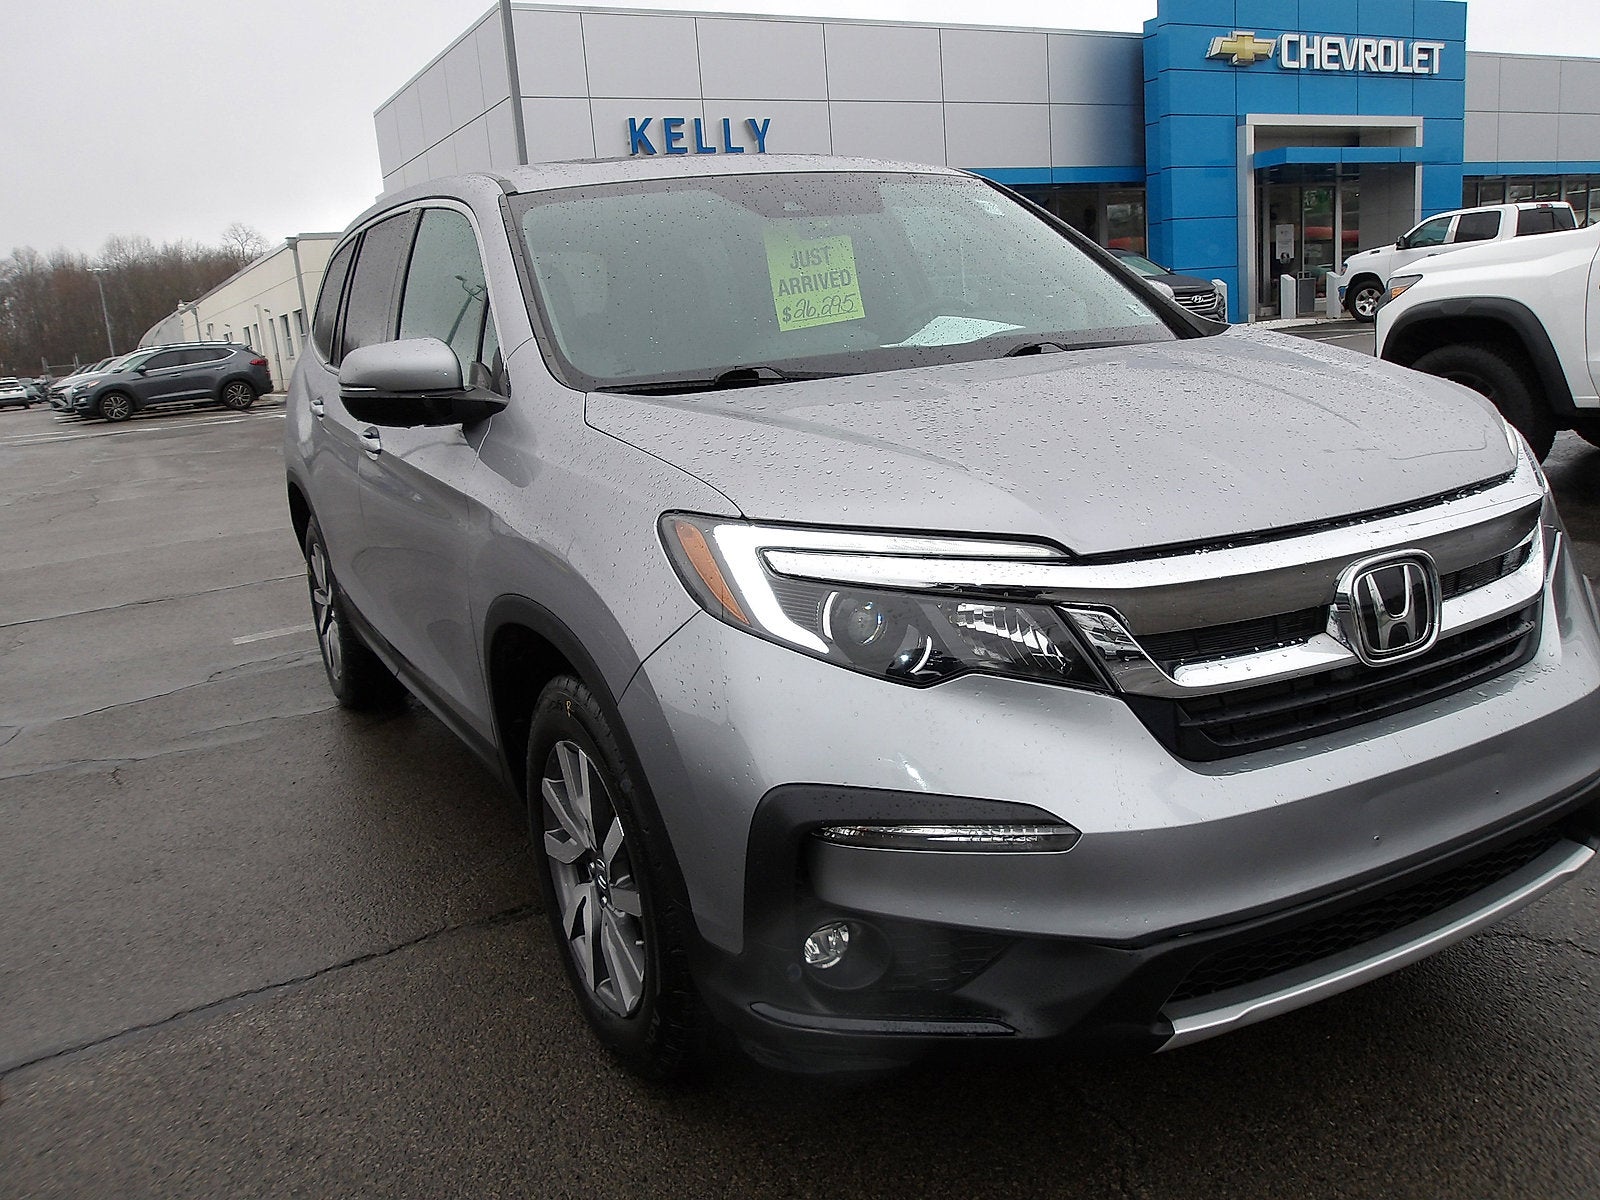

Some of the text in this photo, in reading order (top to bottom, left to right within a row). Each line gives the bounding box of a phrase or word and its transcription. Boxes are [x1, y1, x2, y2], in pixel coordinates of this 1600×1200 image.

[1281, 33, 1445, 75] CHEVROLET
[627, 116, 771, 156] KELLY
[789, 245, 831, 269] JUST
[778, 269, 852, 297] ARRIVED
